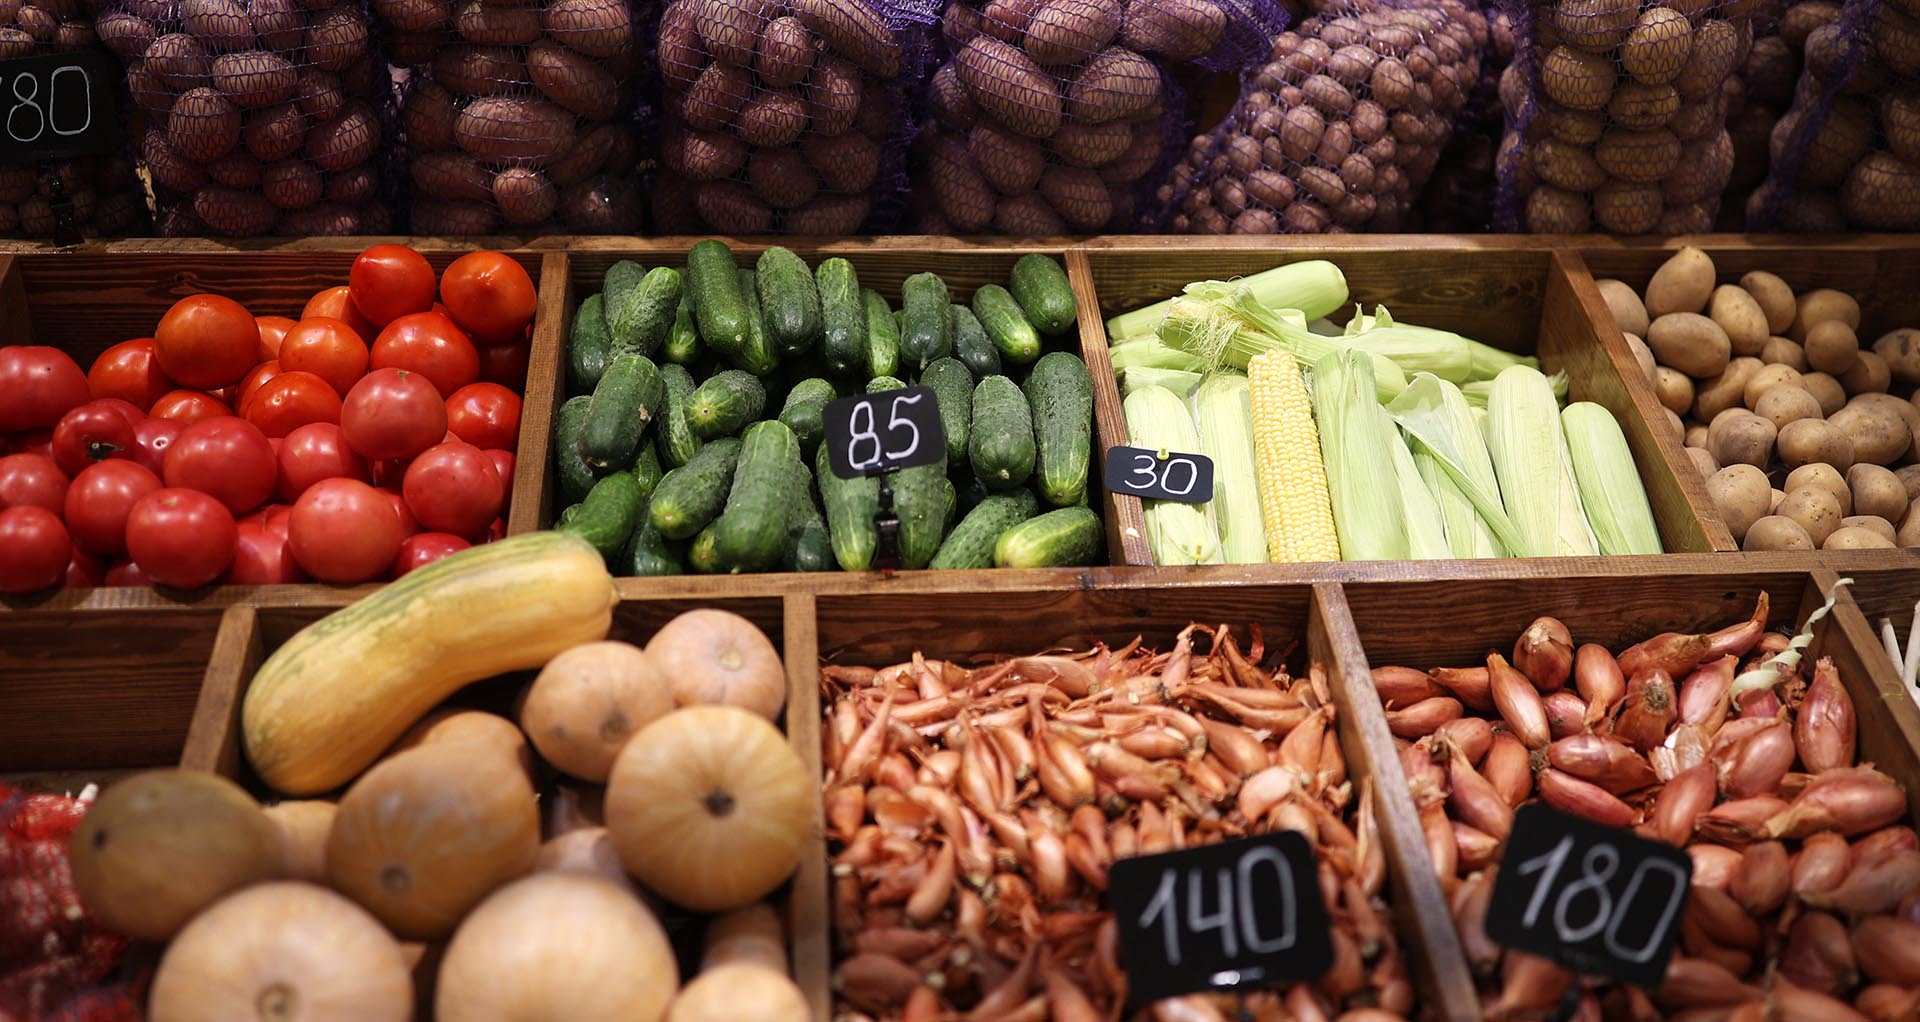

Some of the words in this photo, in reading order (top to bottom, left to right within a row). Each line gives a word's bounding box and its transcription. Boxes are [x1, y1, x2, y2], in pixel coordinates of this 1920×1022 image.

[0, 66, 91, 142] 80
[847, 394, 922, 470] 85
[1124, 454, 1198, 495] 30
[1139, 847, 1297, 965] 140
[1518, 834, 1687, 962] 180
